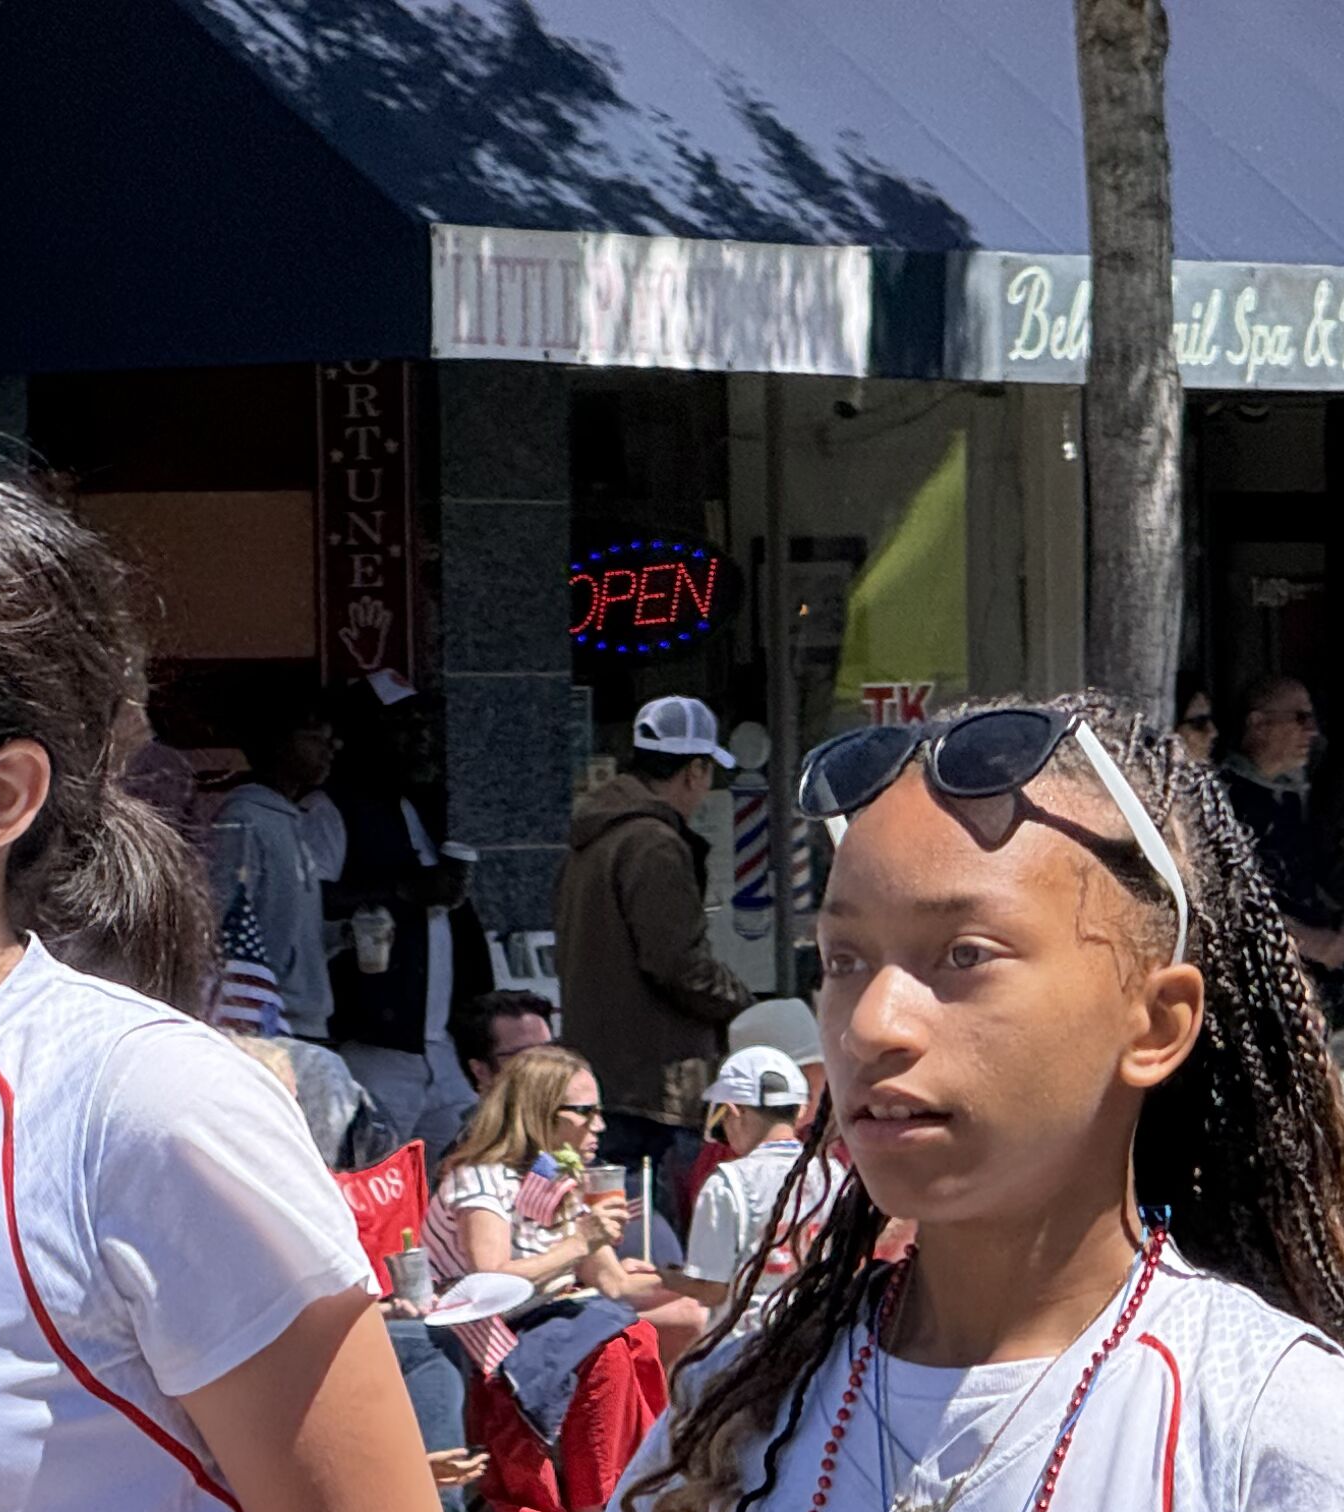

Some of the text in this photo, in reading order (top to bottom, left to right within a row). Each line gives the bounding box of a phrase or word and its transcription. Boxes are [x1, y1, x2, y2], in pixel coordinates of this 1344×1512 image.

[1171, 276, 1218, 366] ail
[1227, 287, 1293, 383] Spa
[1304, 280, 1336, 368] &
[568, 558, 717, 634] OPEN
